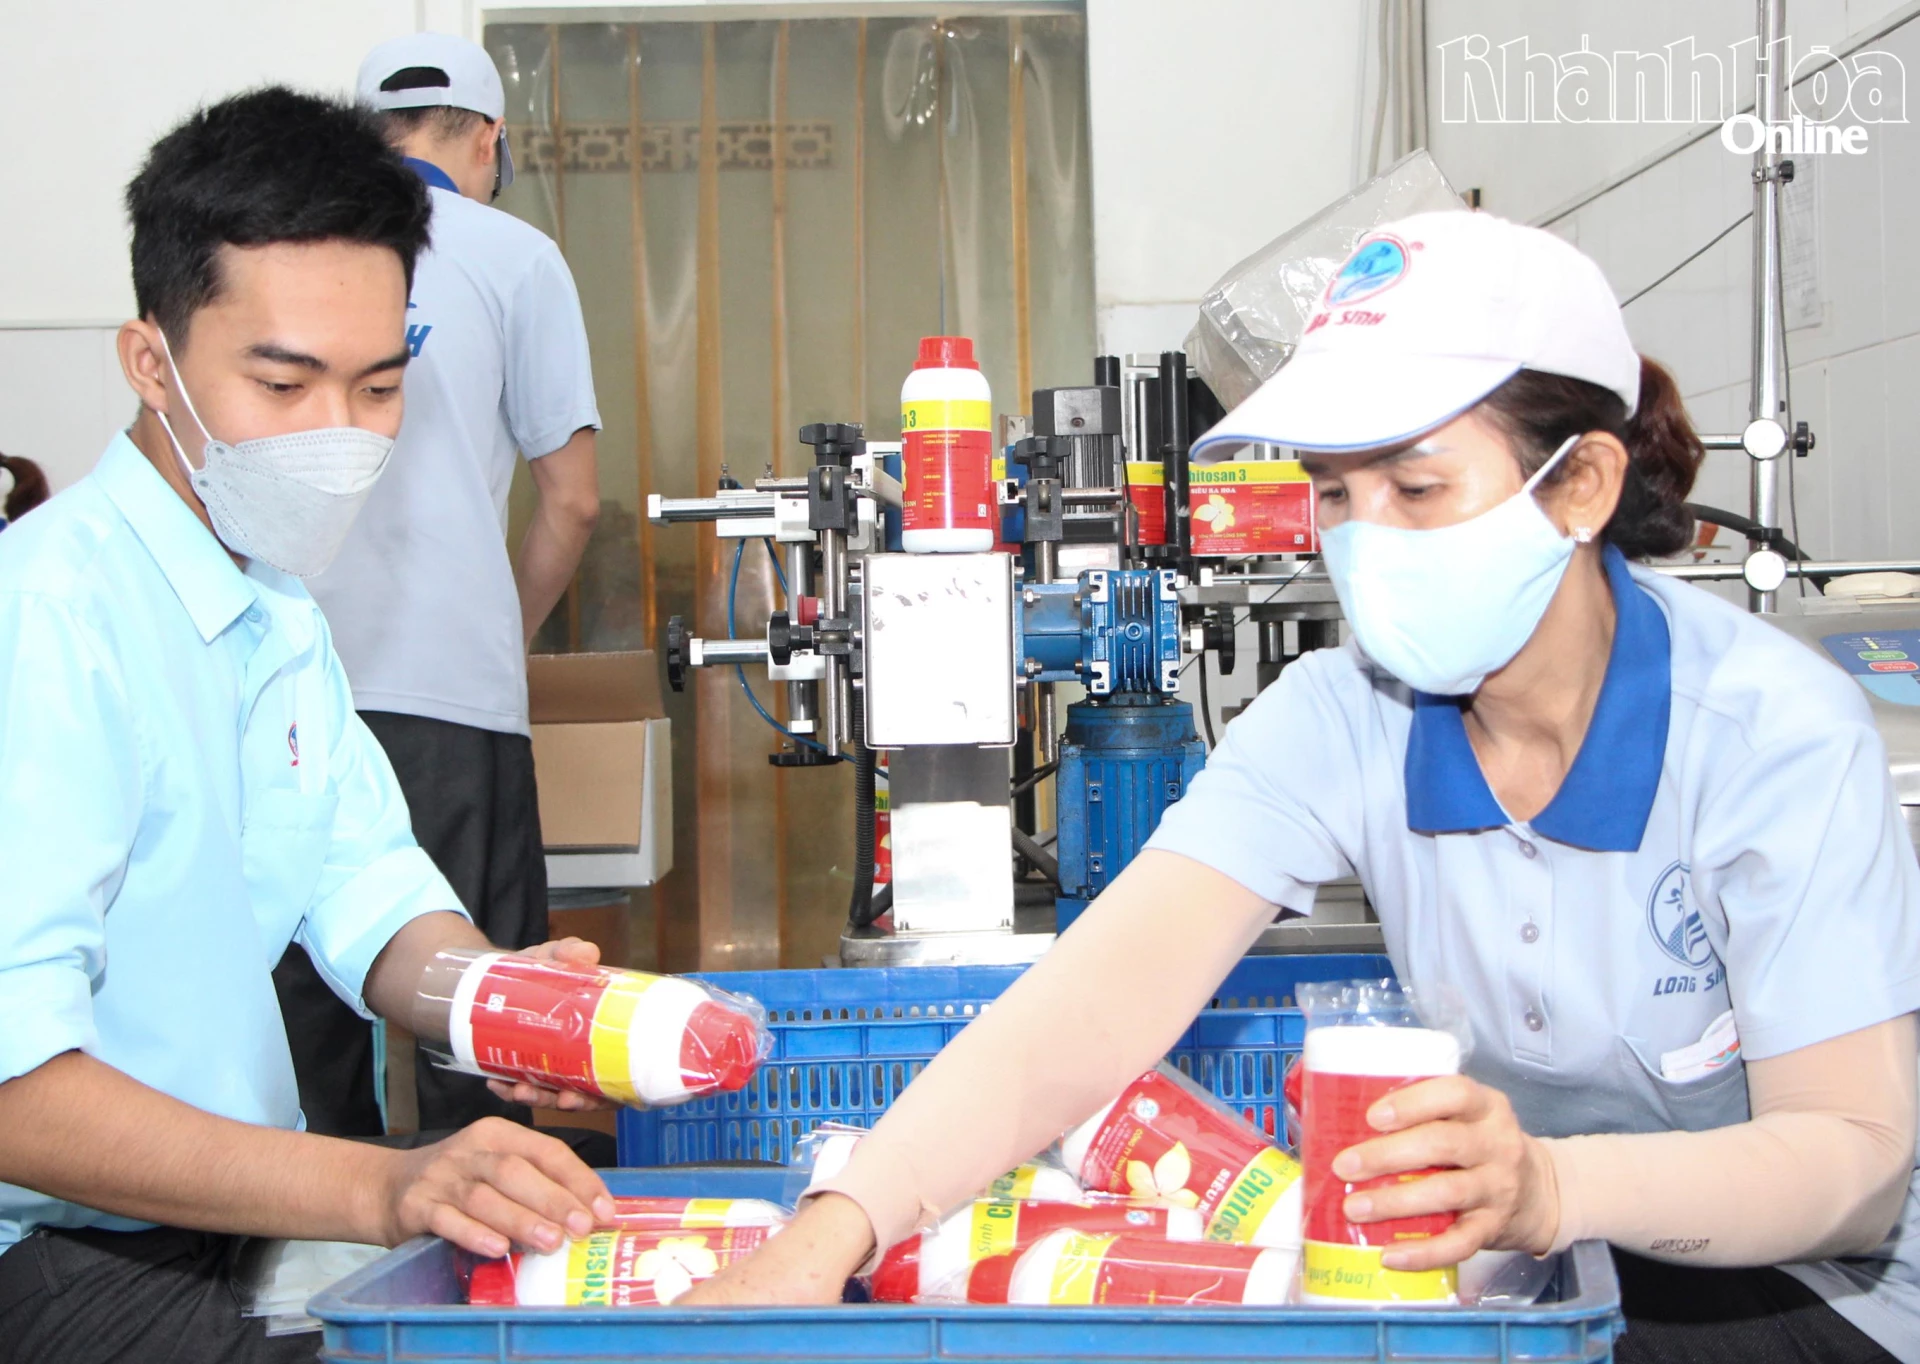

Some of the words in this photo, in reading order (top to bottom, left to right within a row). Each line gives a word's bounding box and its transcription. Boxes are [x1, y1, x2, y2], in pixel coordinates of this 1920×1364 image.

[909, 410, 916, 427] 3
[1189, 470, 1236, 482] hitosan
[1239, 469, 1246, 481] 3
[1653, 976, 1696, 996] LONG
[1704, 967, 1725, 992] SI
[1208, 1168, 1273, 1241] Chitos
[977, 1223, 993, 1253] Sinh
[581, 1235, 612, 1306] itosan
[1335, 1266, 1373, 1289] Long
